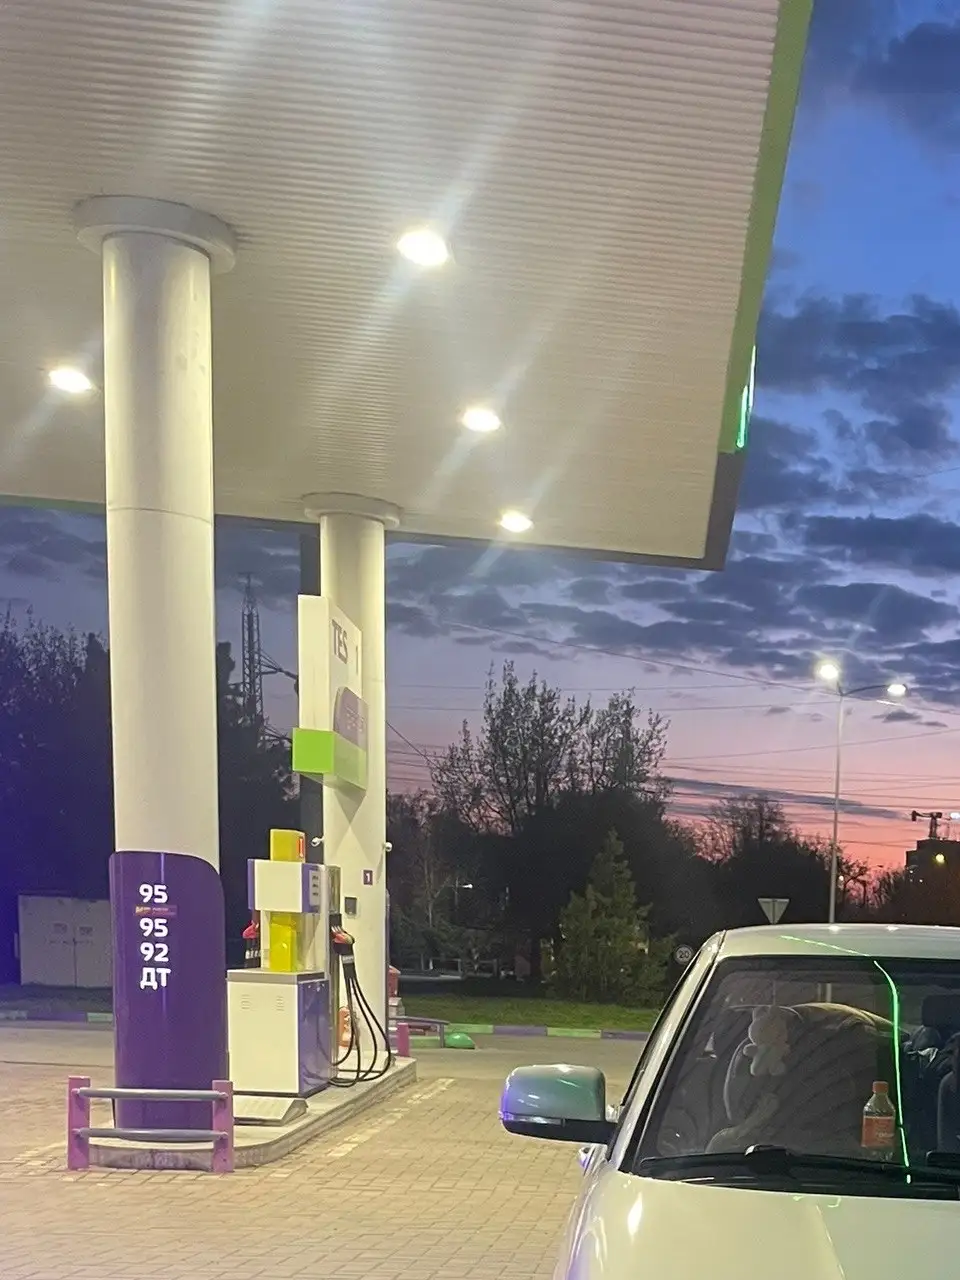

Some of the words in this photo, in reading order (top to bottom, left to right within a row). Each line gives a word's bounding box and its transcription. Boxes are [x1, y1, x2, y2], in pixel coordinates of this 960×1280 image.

[331, 619, 348, 665] TES
[139, 884, 168, 903] 95
[140, 917, 168, 937] 95
[140, 942, 169, 962] 92
[679, 950, 690, 959] 20
[140, 967, 171, 990] ДТ
